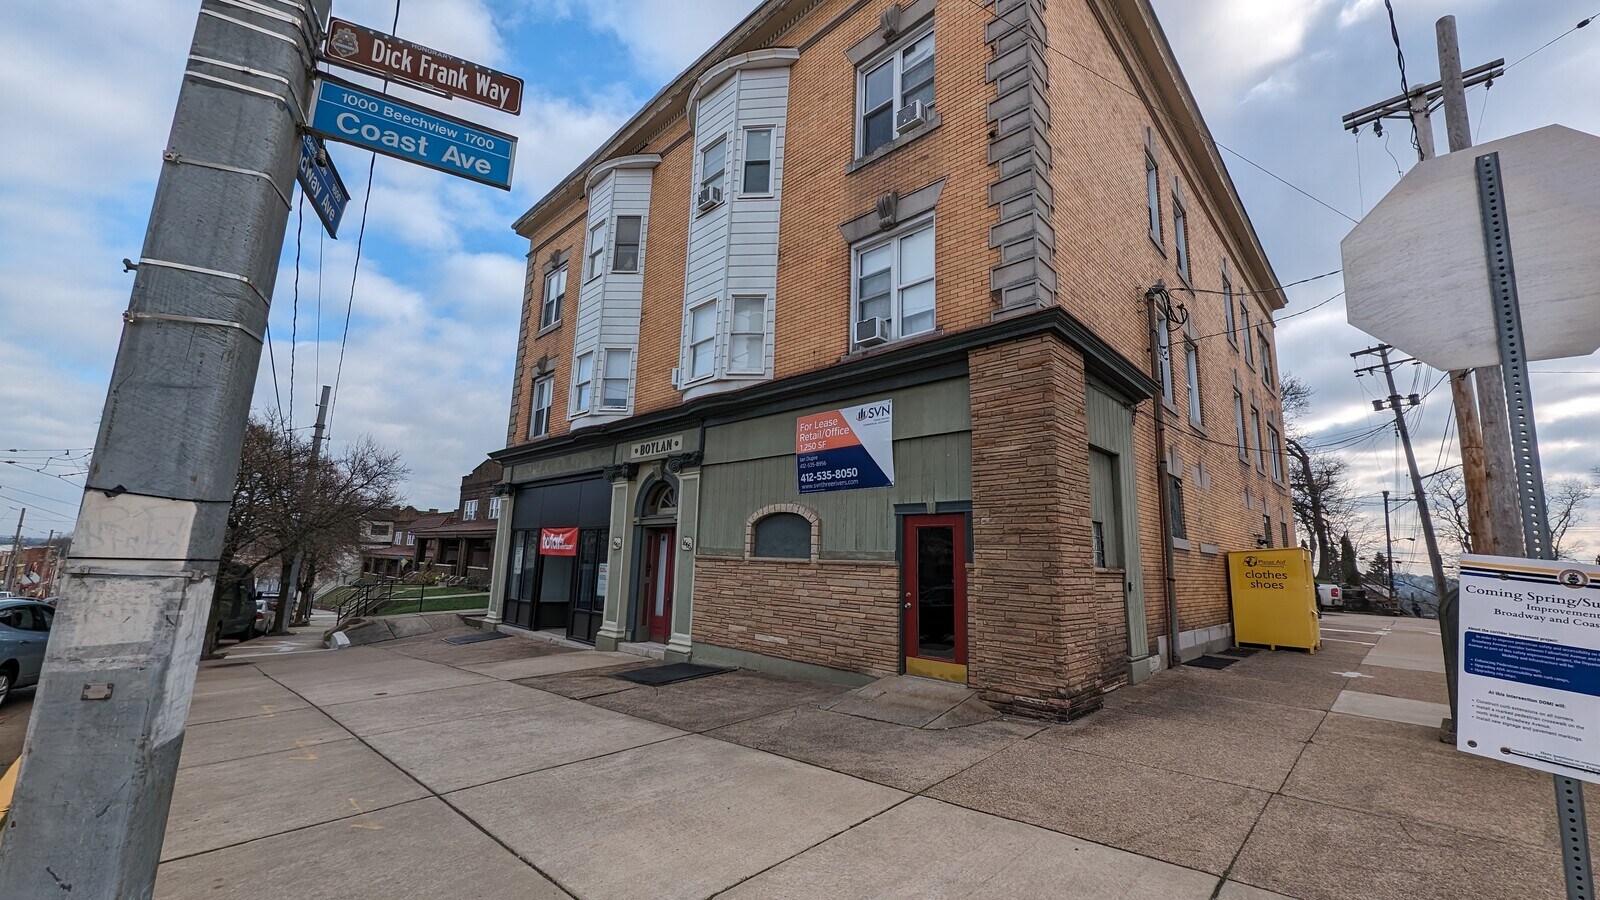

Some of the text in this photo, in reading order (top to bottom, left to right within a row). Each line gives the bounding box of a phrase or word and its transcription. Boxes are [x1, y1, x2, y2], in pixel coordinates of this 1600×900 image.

[411, 43, 453, 61] HONORARY
[371, 38, 510, 110] Dick Frank Way
[341, 92, 495, 151] 1000 Beechview 1700
[336, 112, 492, 176] Coast Ave
[321, 193, 336, 222] Ave
[868, 404, 890, 418] SVN
[800, 418, 838, 432] For Lease
[800, 426, 850, 442] Retail/Office
[640, 439, 673, 456] BOYLAN
[818, 440, 827, 448] SF
[800, 468, 858, 482] 412-535-8050
[802, 480, 858, 489] www.svnthreerivers.com
[1246, 570, 1288, 580] clothes
[1250, 580, 1284, 590] shoes
[1465, 584, 1522, 602] Coming
[1494, 608, 1546, 623] Broadway
[1549, 616, 1569, 624] and
[1509, 632, 1539, 640] improvement
[1506, 694, 1538, 703] intersection
[1512, 706, 1538, 715] extensions
[1507, 716, 1530, 725] Broadway
[1514, 713, 1541, 722] pedestrian
[1542, 718, 1567, 727] crosswalk
[1532, 728, 1557, 736] pavement
